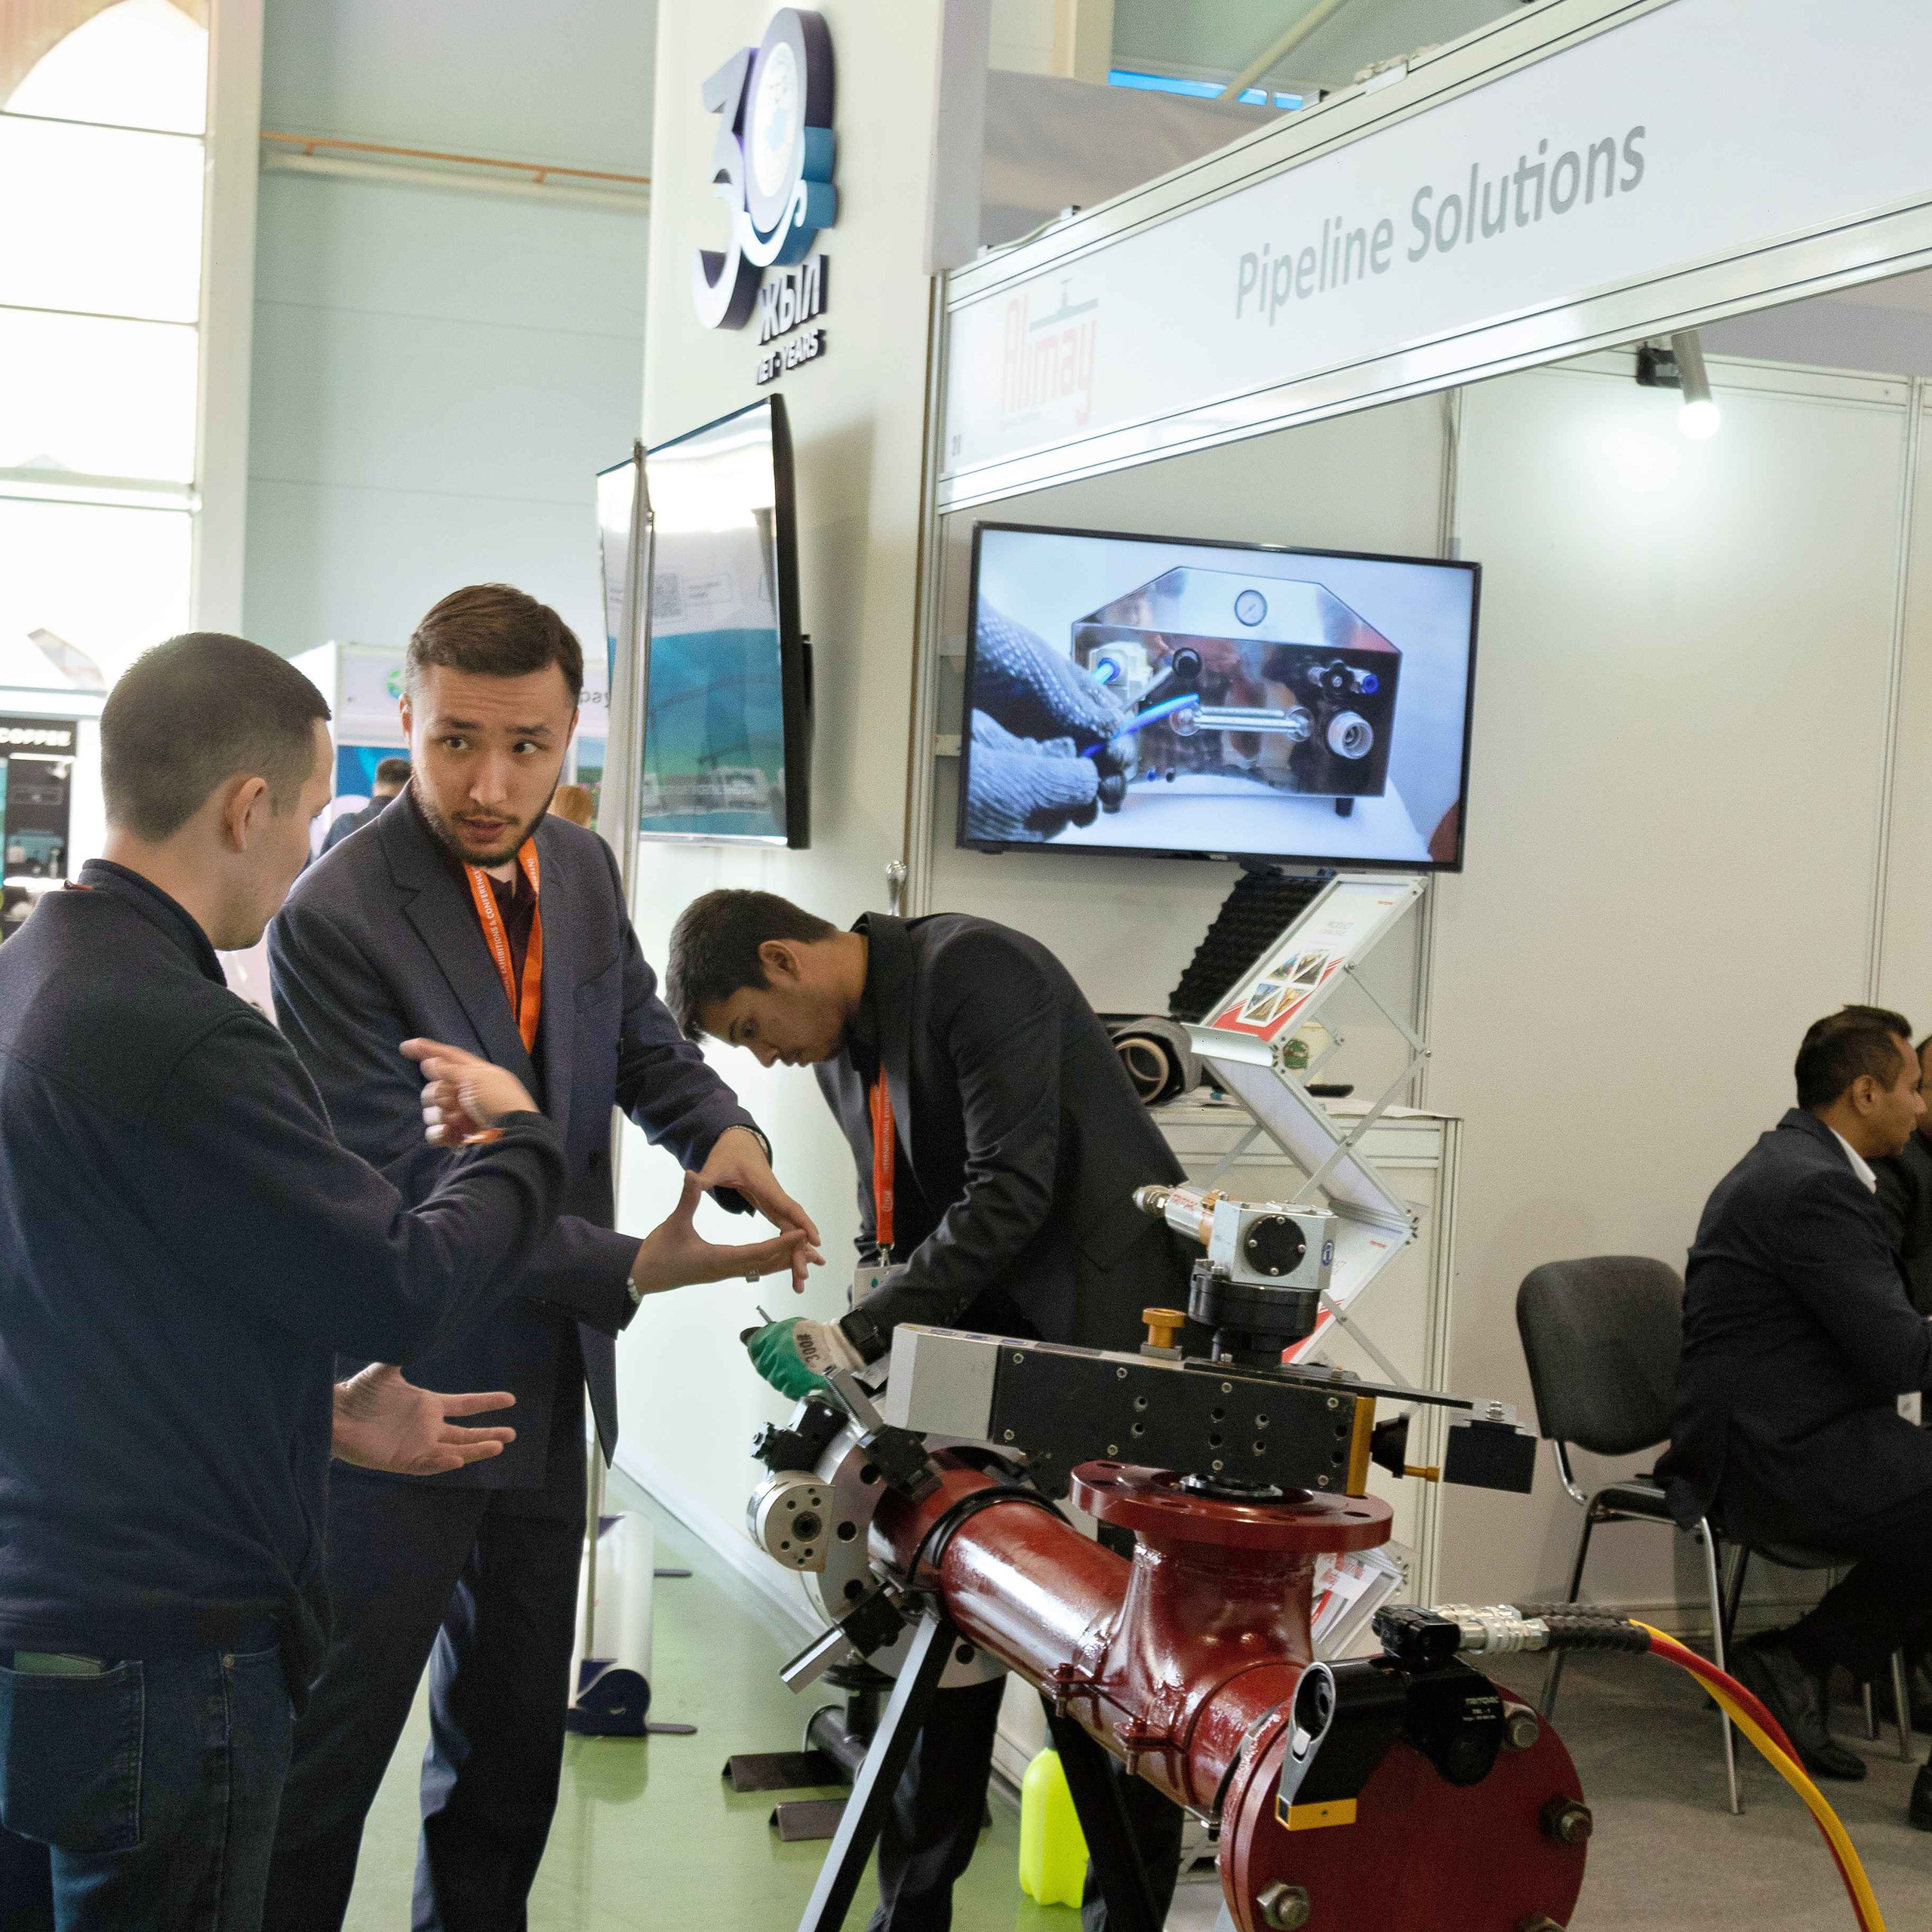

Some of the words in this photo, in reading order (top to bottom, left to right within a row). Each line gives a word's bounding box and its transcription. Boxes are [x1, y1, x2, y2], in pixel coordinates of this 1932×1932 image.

[1236, 216, 1394, 327] Pipeline
[1407, 125, 1646, 263] Solutions
[756, 254, 823, 346] ЖЫЛ
[782, 329, 822, 370] YEARS
